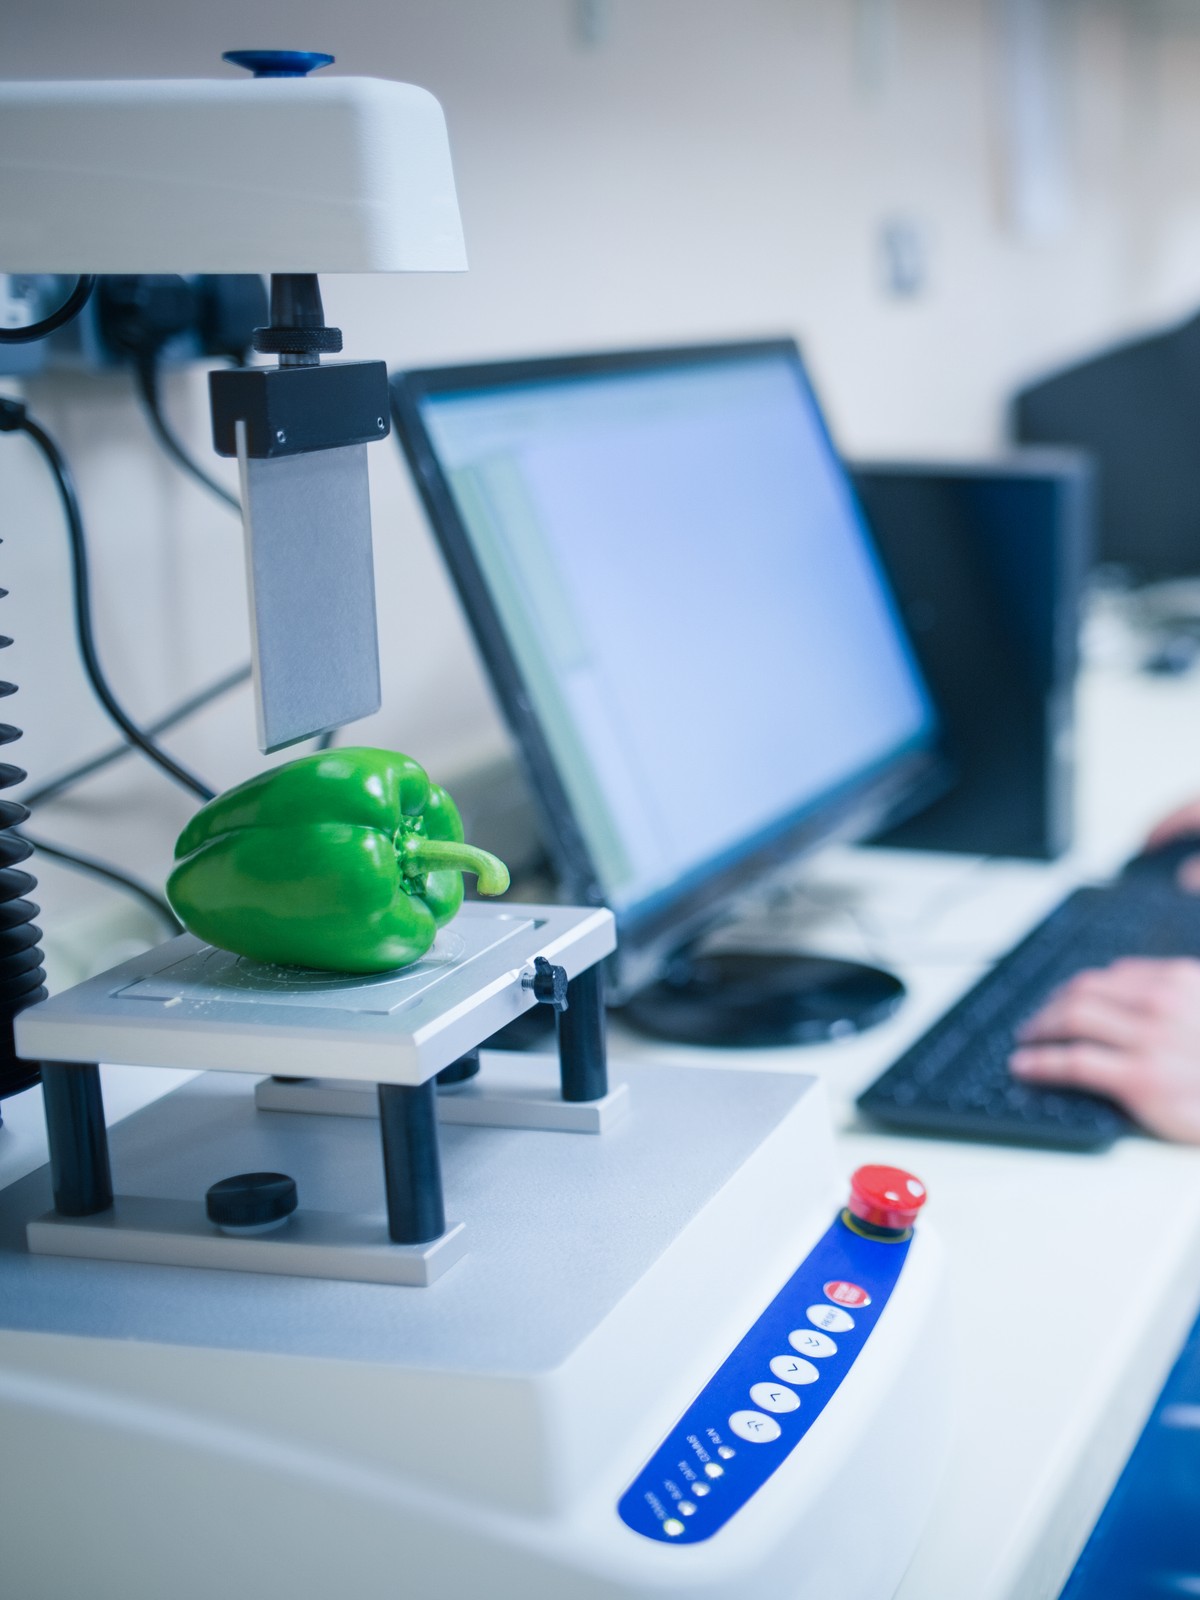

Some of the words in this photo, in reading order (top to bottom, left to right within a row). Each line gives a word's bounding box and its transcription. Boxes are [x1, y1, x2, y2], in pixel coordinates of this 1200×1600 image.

[706, 1428, 722, 1444] RUN
[687, 1434, 710, 1462] COMMS
[678, 1461, 697, 1480] DATA
